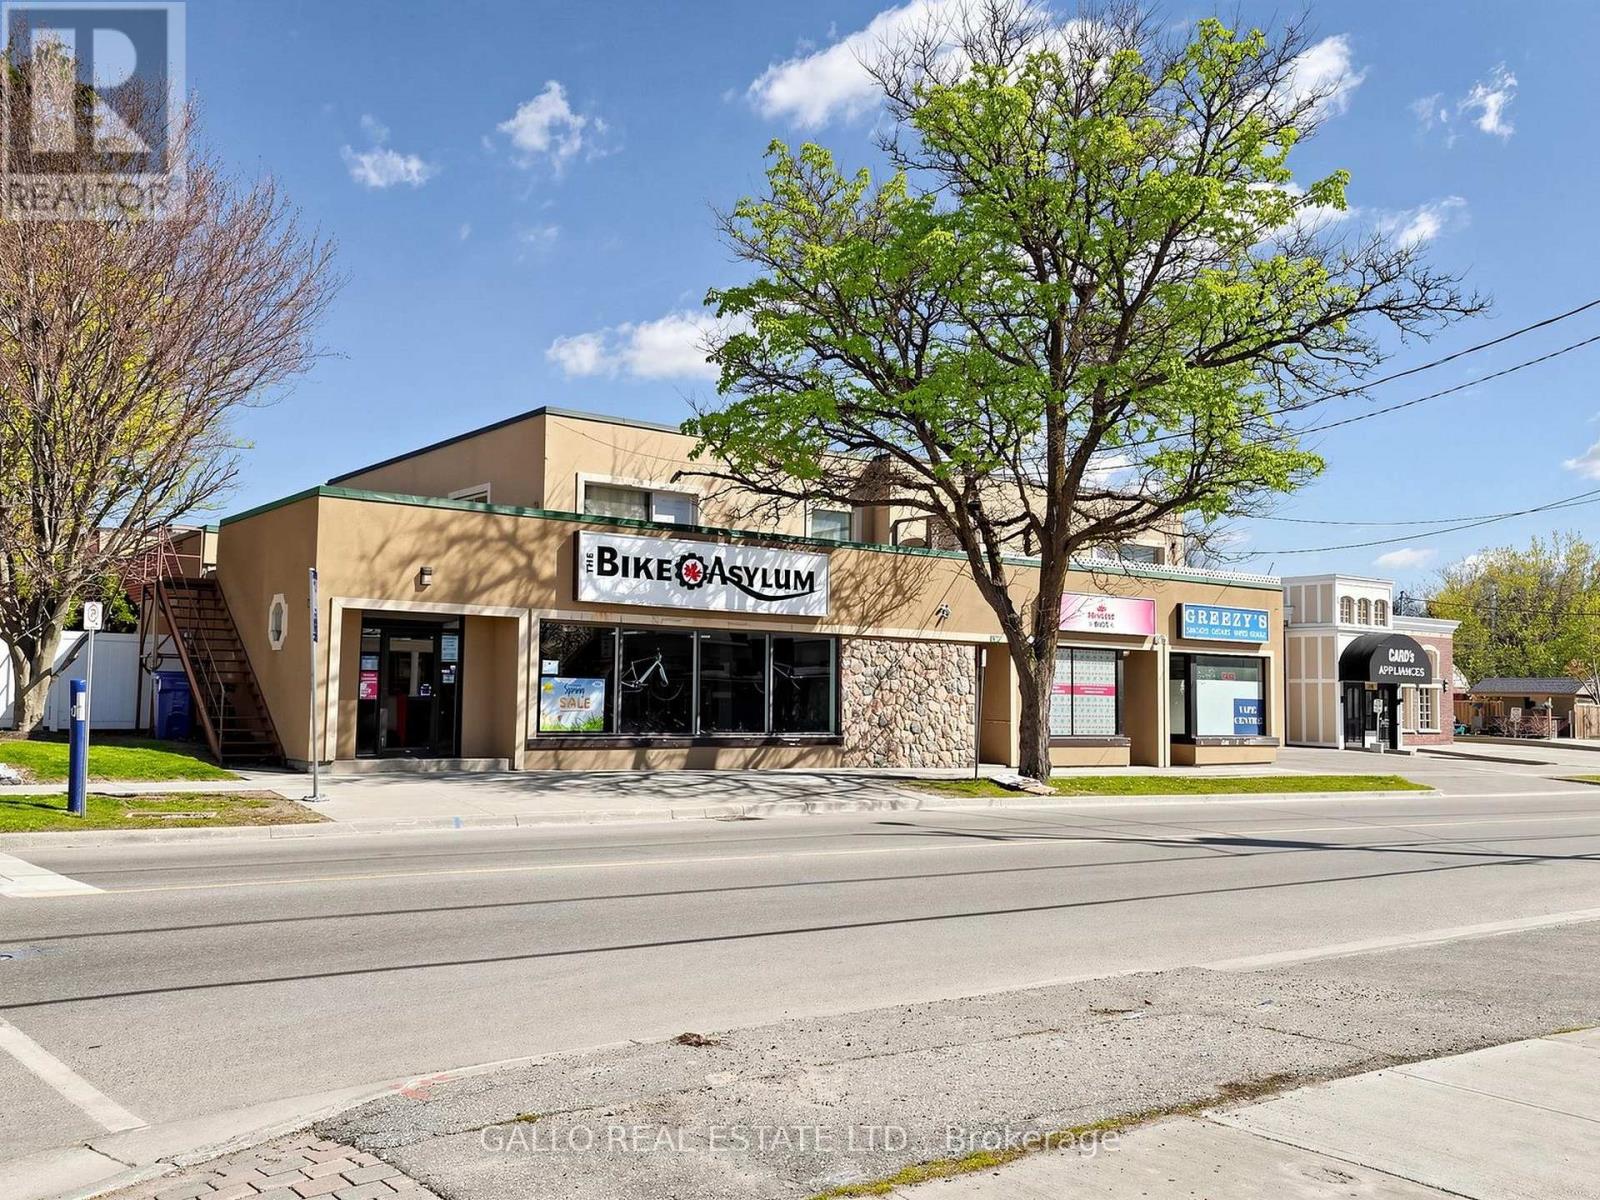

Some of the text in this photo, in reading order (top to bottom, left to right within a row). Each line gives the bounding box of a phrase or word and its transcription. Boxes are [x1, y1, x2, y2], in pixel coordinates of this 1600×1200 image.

[586, 552, 595, 574] THE
[1185, 609, 1267, 629] GREEZY'S
[1379, 665, 1425, 677] APPLIANCES
[560, 697, 591, 709] SALE
